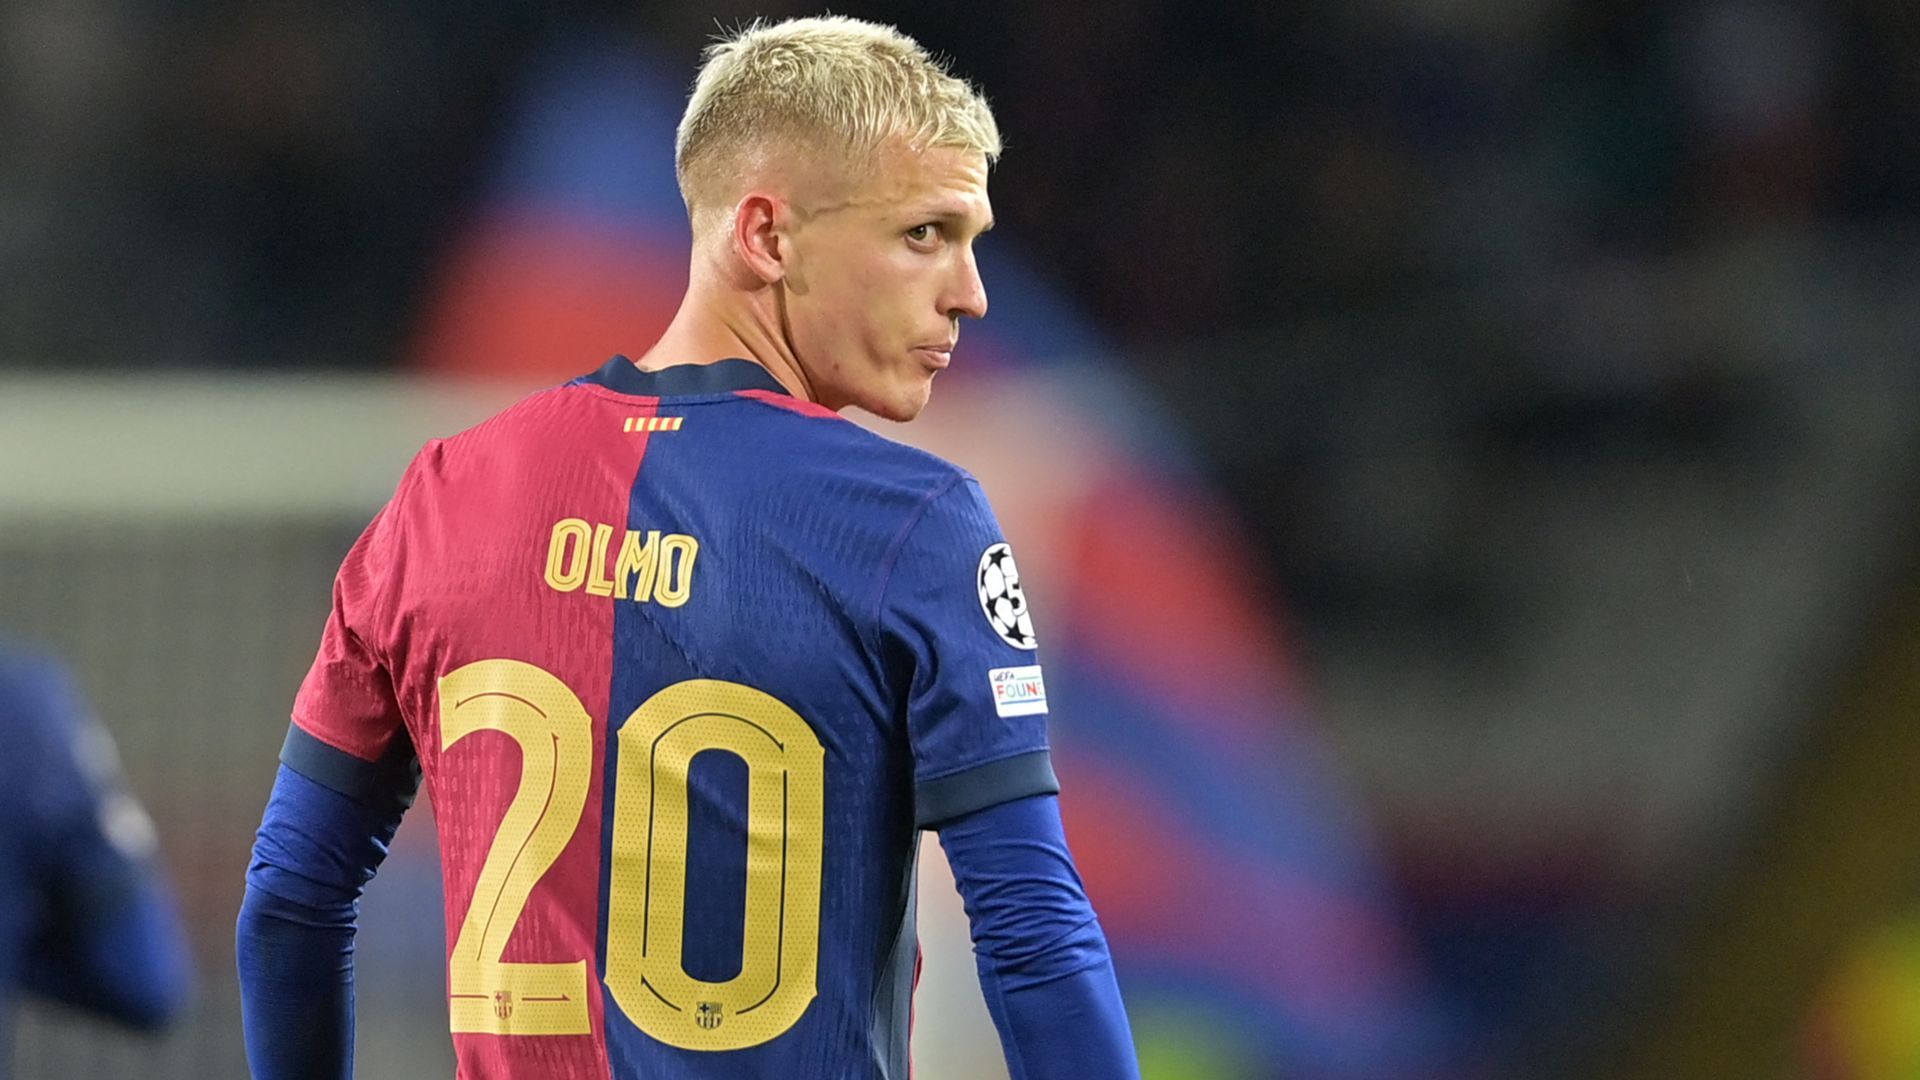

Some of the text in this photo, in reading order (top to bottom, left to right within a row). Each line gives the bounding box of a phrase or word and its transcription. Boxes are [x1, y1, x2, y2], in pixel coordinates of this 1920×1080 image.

[544, 518, 699, 608] OLMO
[1004, 575, 1027, 616] 5
[438, 659, 825, 1051] 20
